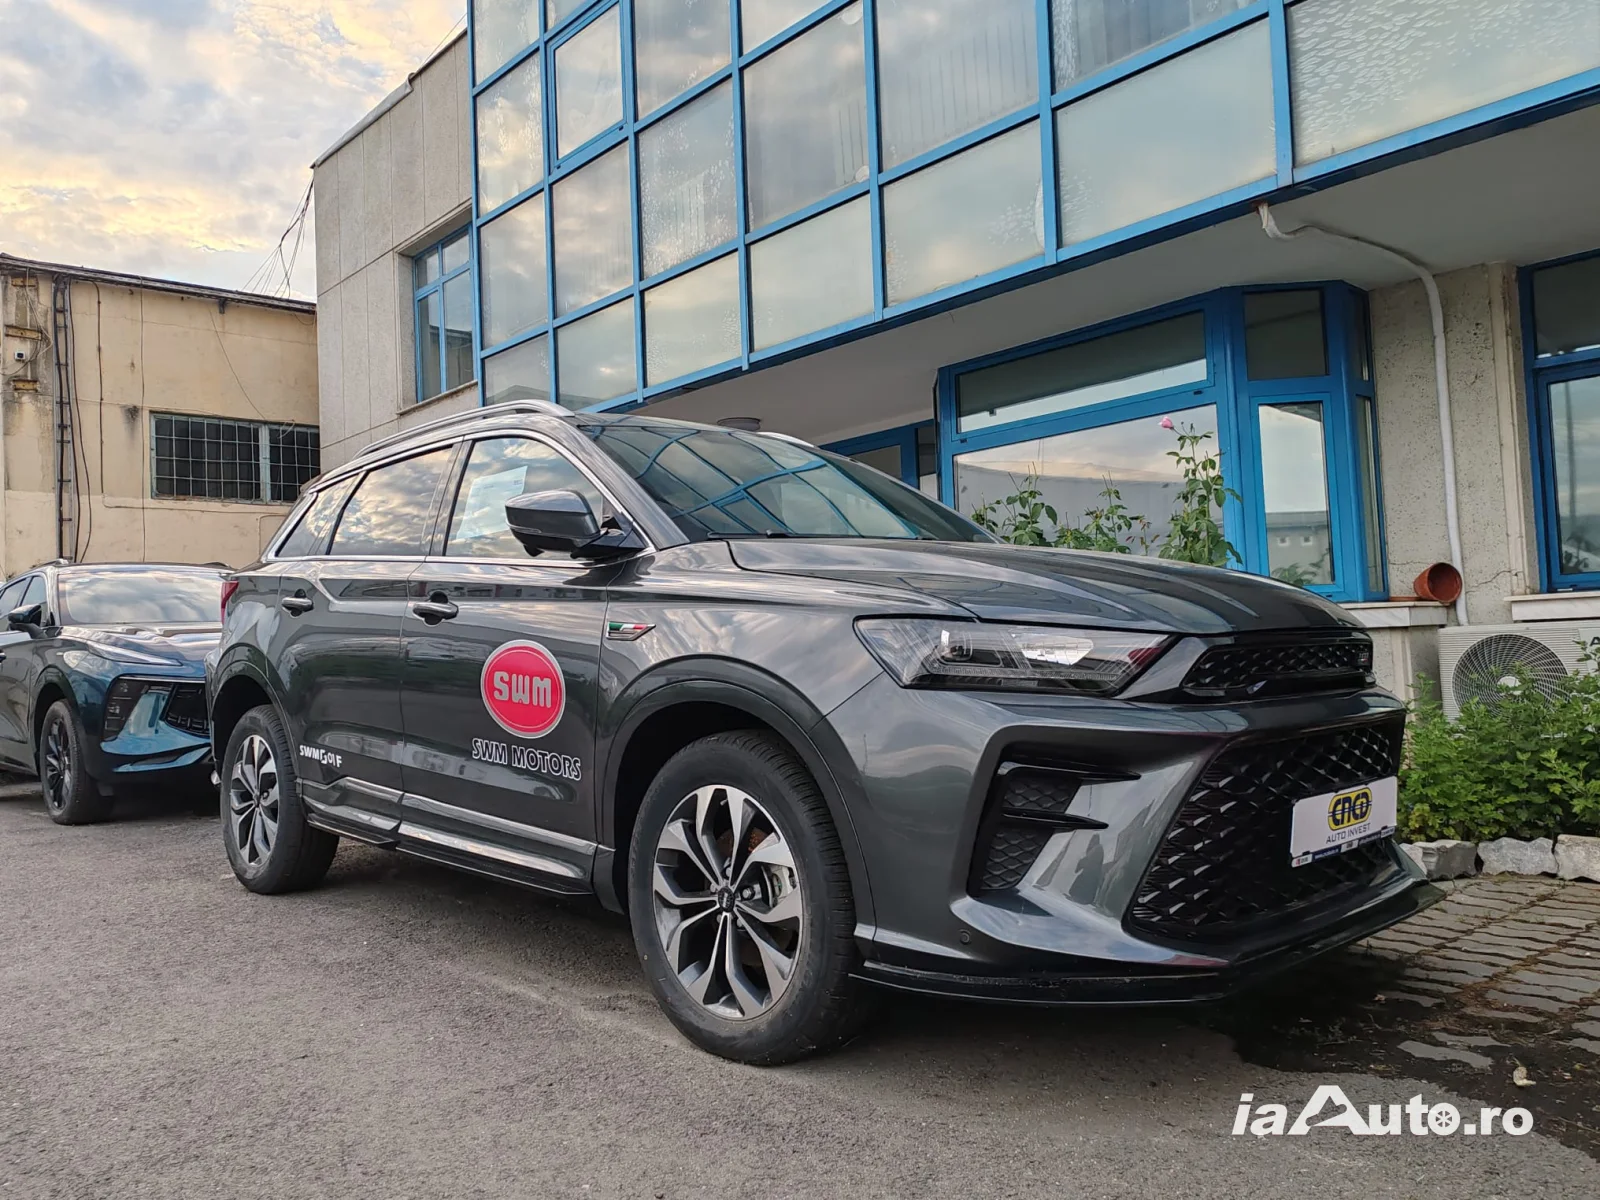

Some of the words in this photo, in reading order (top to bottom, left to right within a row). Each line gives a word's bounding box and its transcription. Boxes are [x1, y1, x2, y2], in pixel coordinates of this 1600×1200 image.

[493, 671, 552, 708] SWM
[472, 738, 508, 765] SWM
[511, 744, 582, 781] MOTORS
[1326, 831, 1346, 844] AUTO
[1347, 822, 1371, 839] INVEST
